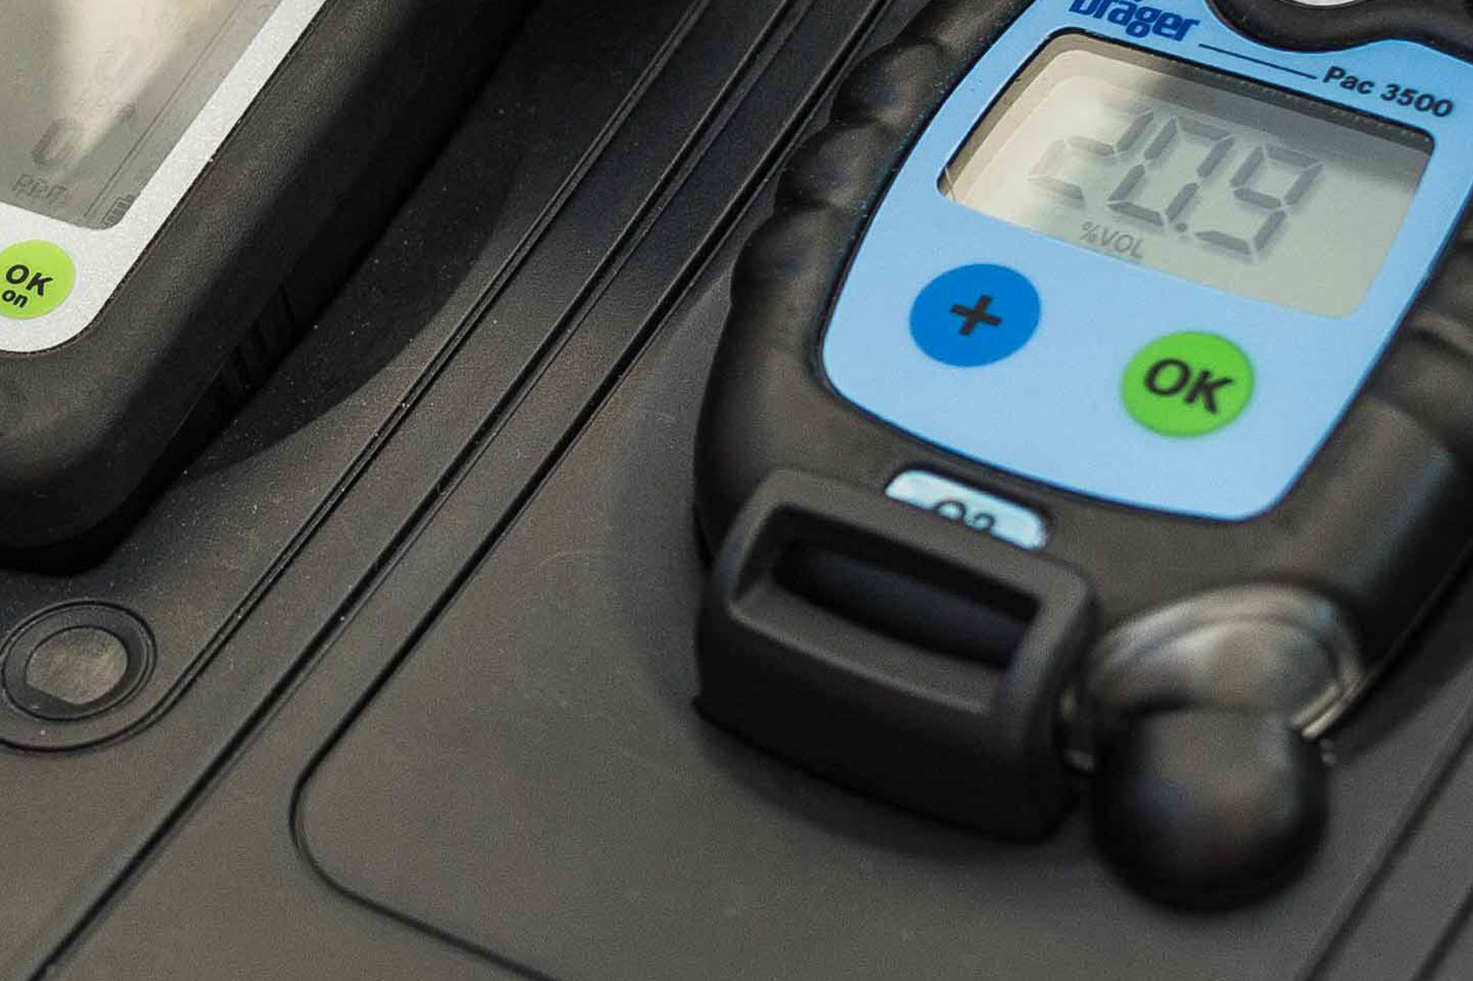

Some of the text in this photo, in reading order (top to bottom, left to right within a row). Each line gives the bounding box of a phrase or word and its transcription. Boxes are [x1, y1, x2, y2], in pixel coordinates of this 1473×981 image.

[1322, 65, 1373, 96] Pac
[1380, 83, 1454, 118] 3500
[1025, 92, 1325, 256] 20.9
[1079, 220, 1147, 262] %VOL
[1, 288, 29, 309] on
[5, 264, 54, 296] OK
[1142, 357, 1234, 415] OK
